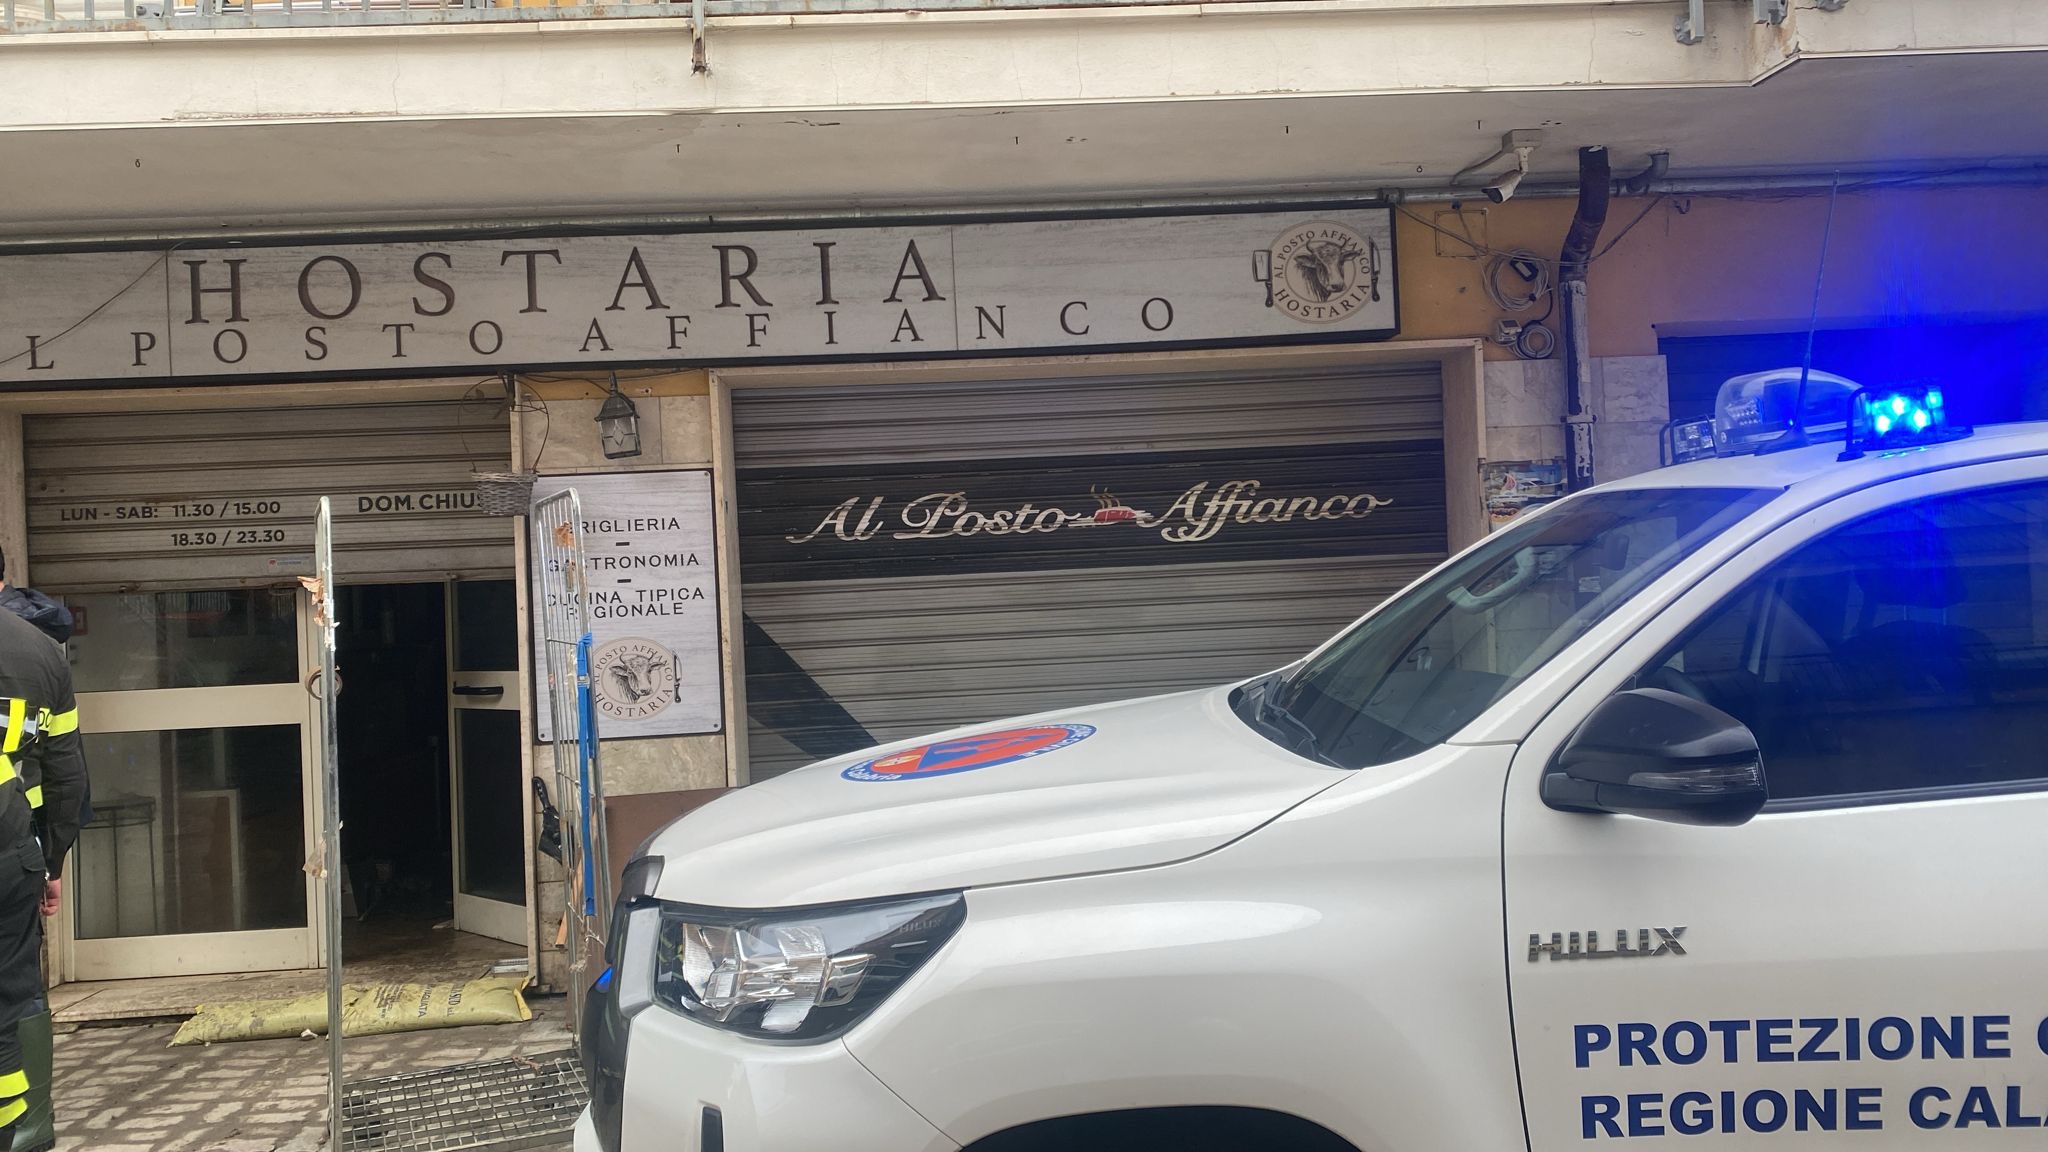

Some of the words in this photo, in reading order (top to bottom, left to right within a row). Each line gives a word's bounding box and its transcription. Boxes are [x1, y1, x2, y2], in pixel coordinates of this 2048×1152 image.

[1277, 230, 1315, 261] POSTO
[182, 238, 946, 324] HOSTARIA
[1274, 264, 1284, 279] AL
[1274, 284, 1370, 318] HOSTARIA
[130, 320, 503, 367] POSTO
[579, 297, 1174, 351] AFFIANCO
[61, 507, 97, 521] LUN
[116, 505, 158, 519] SAB:
[172, 503, 214, 517] 11.30
[234, 501, 281, 515] 15.00
[786, 496, 884, 543] Al
[893, 492, 1081, 540] Posto
[1137, 480, 1393, 542] Affianco
[171, 532, 217, 546] 18.30
[237, 529, 285, 544] 23.30
[569, 517, 681, 535] RIGLIERIA
[549, 553, 700, 573] GTRONOMIA
[636, 587, 704, 602] TIPICA
[566, 602, 684, 619] RGIONALE
[595, 645, 627, 670] POSTO
[595, 688, 673, 717] HOSTARIA
[1528, 926, 1688, 962] HILUX
[1573, 1015, 2011, 1068] PROTEZIONE
[1581, 1087, 1884, 1140] REGIONE
[1909, 1085, 2048, 1129] CAL
